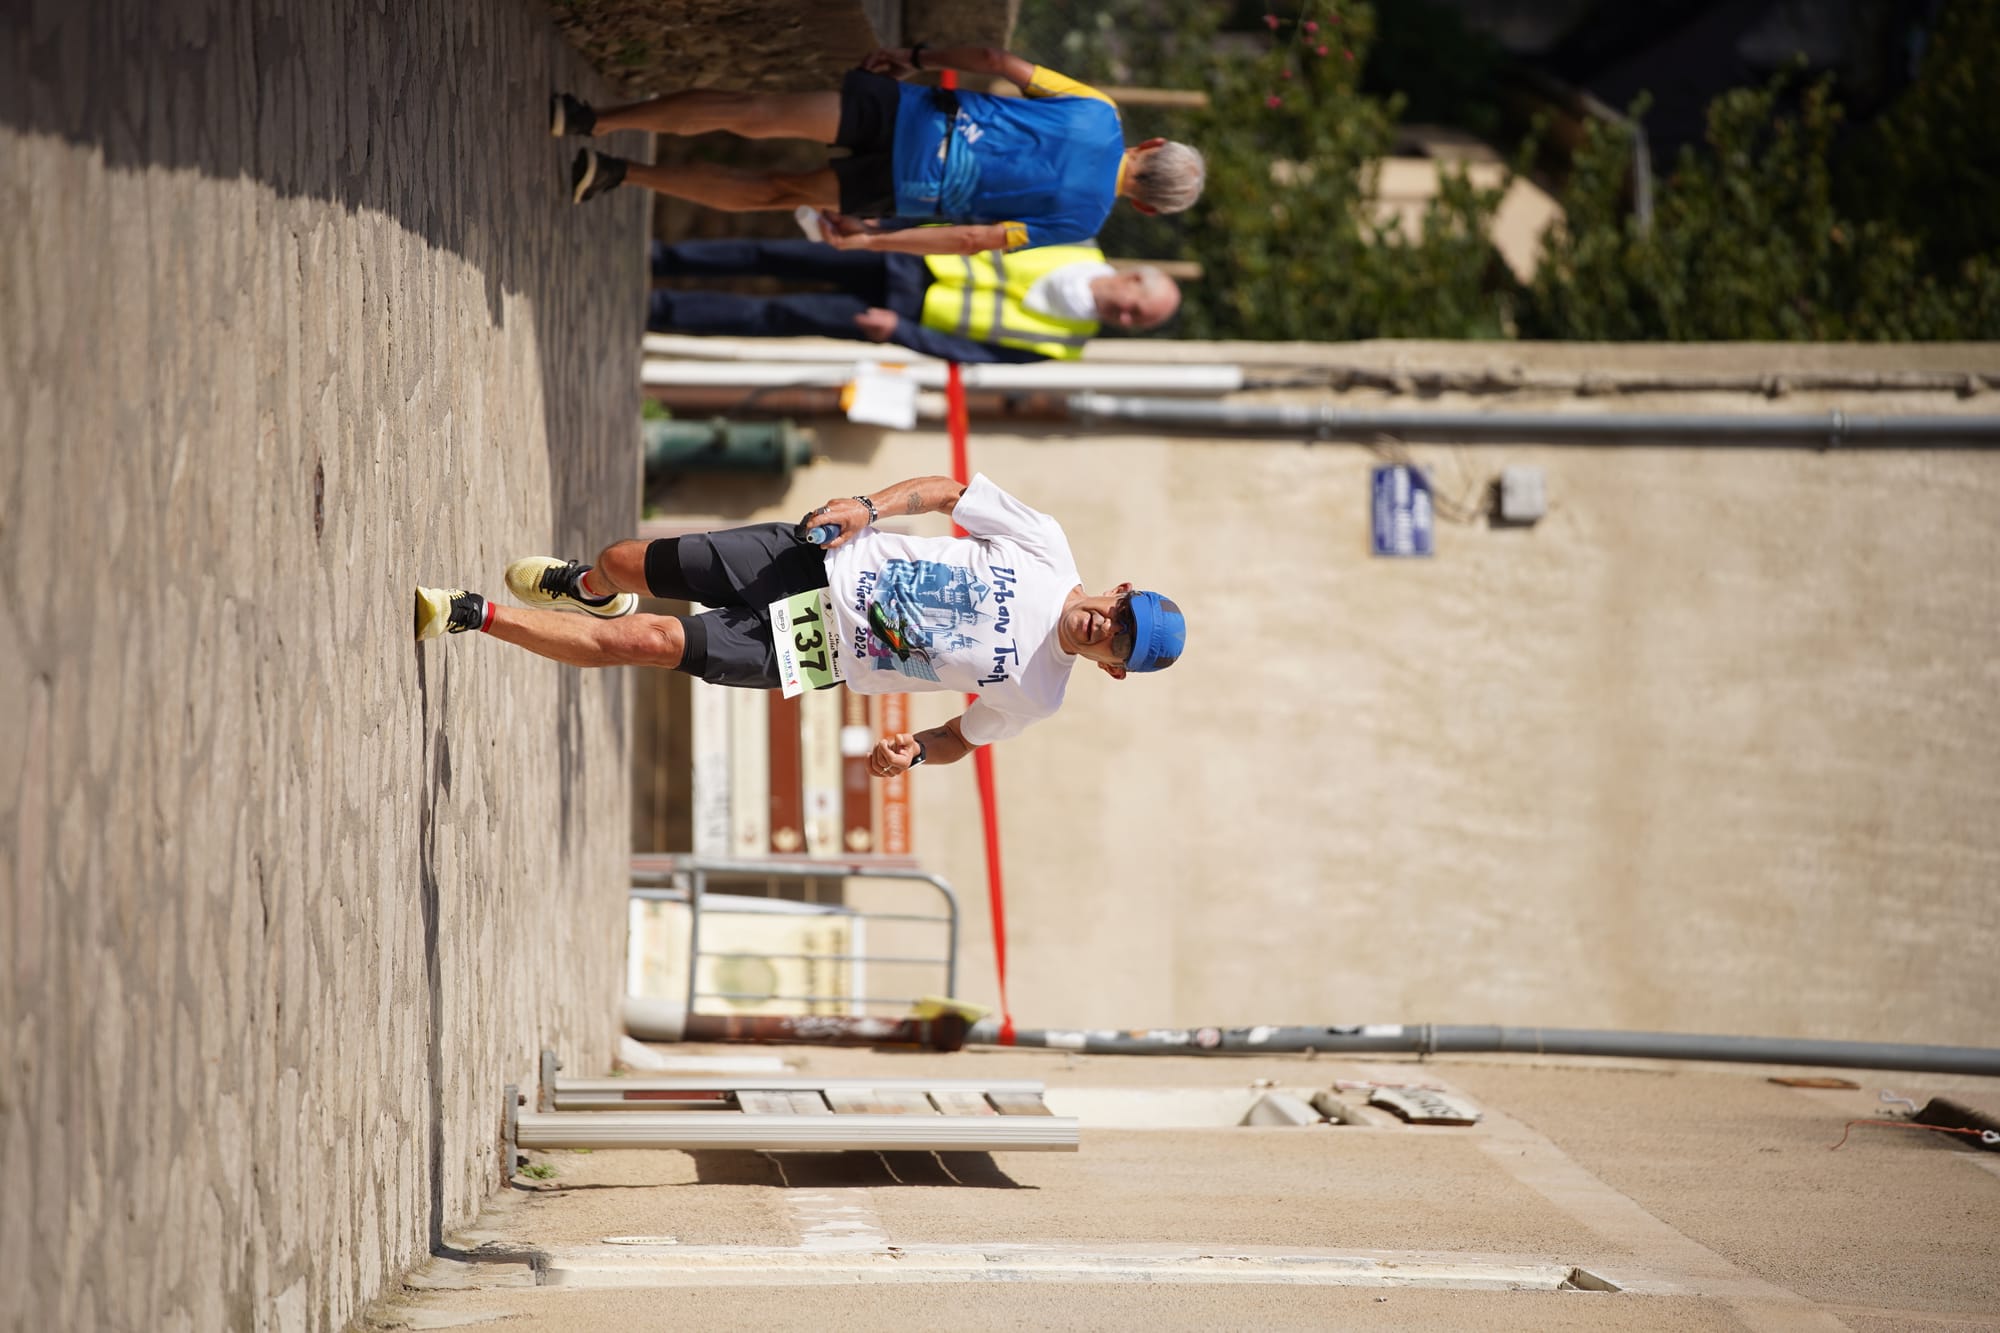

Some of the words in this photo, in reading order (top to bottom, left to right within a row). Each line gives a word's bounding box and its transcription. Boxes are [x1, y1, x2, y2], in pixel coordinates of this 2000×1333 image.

[989, 565, 1016, 634] Urban
[793, 606, 827, 672] 137
[854, 625, 868, 659] 2024
